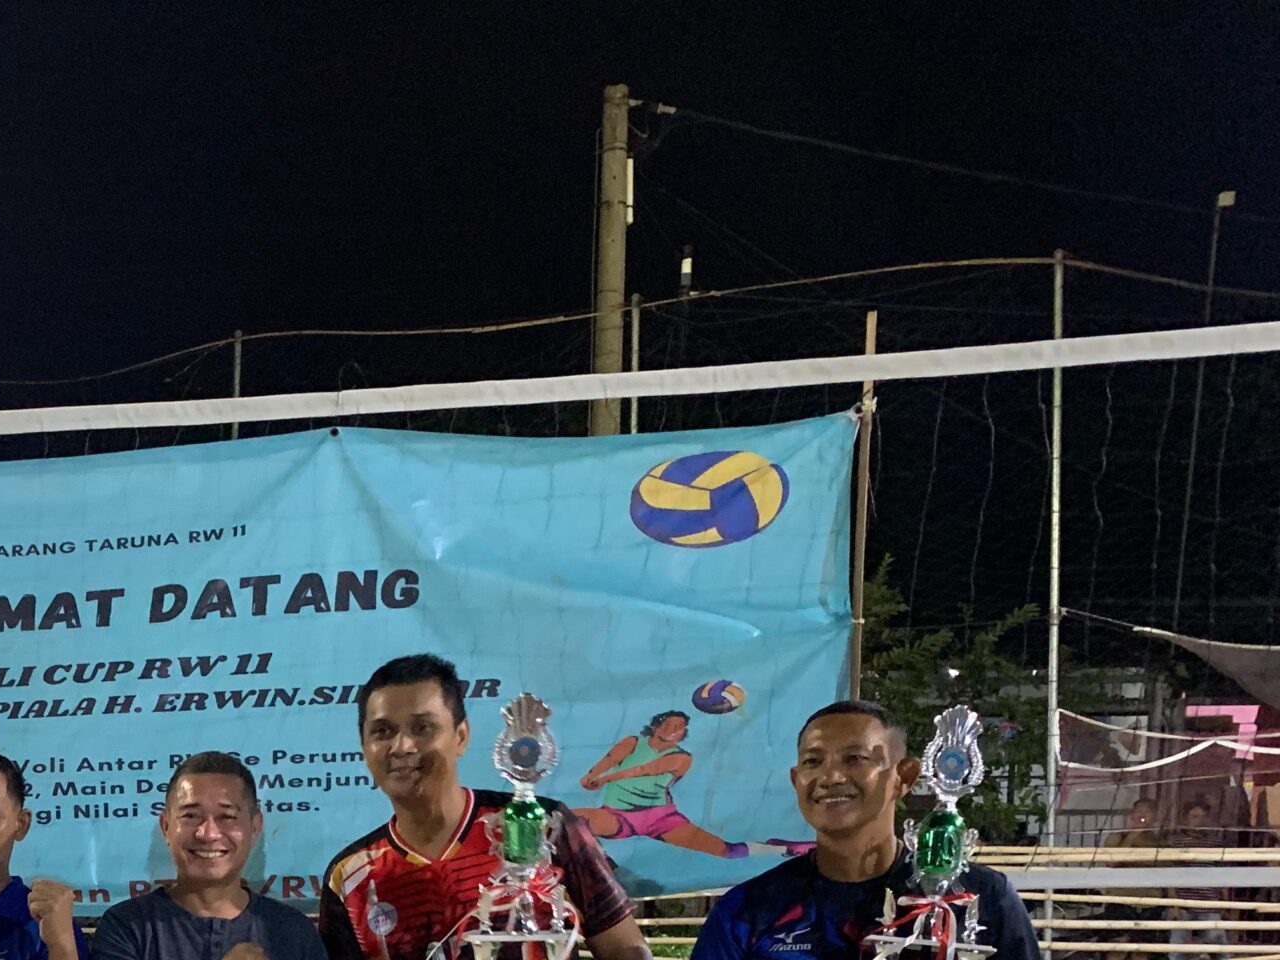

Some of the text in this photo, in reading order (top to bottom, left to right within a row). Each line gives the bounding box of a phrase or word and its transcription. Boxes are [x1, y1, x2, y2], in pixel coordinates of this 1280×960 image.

[84, 532, 180, 552] TARUNA
[189, 527, 225, 544] RW
[232, 524, 247, 538] 11
[149, 569, 420, 624] DATANG
[43, 660, 135, 685] CUP
[137, 655, 227, 680] RW
[230, 653, 273, 675] 11
[102, 695, 143, 714] H.
[76, 756, 158, 772] Antar
[52, 781, 125, 797] Main
[73, 803, 139, 819] Nilai
